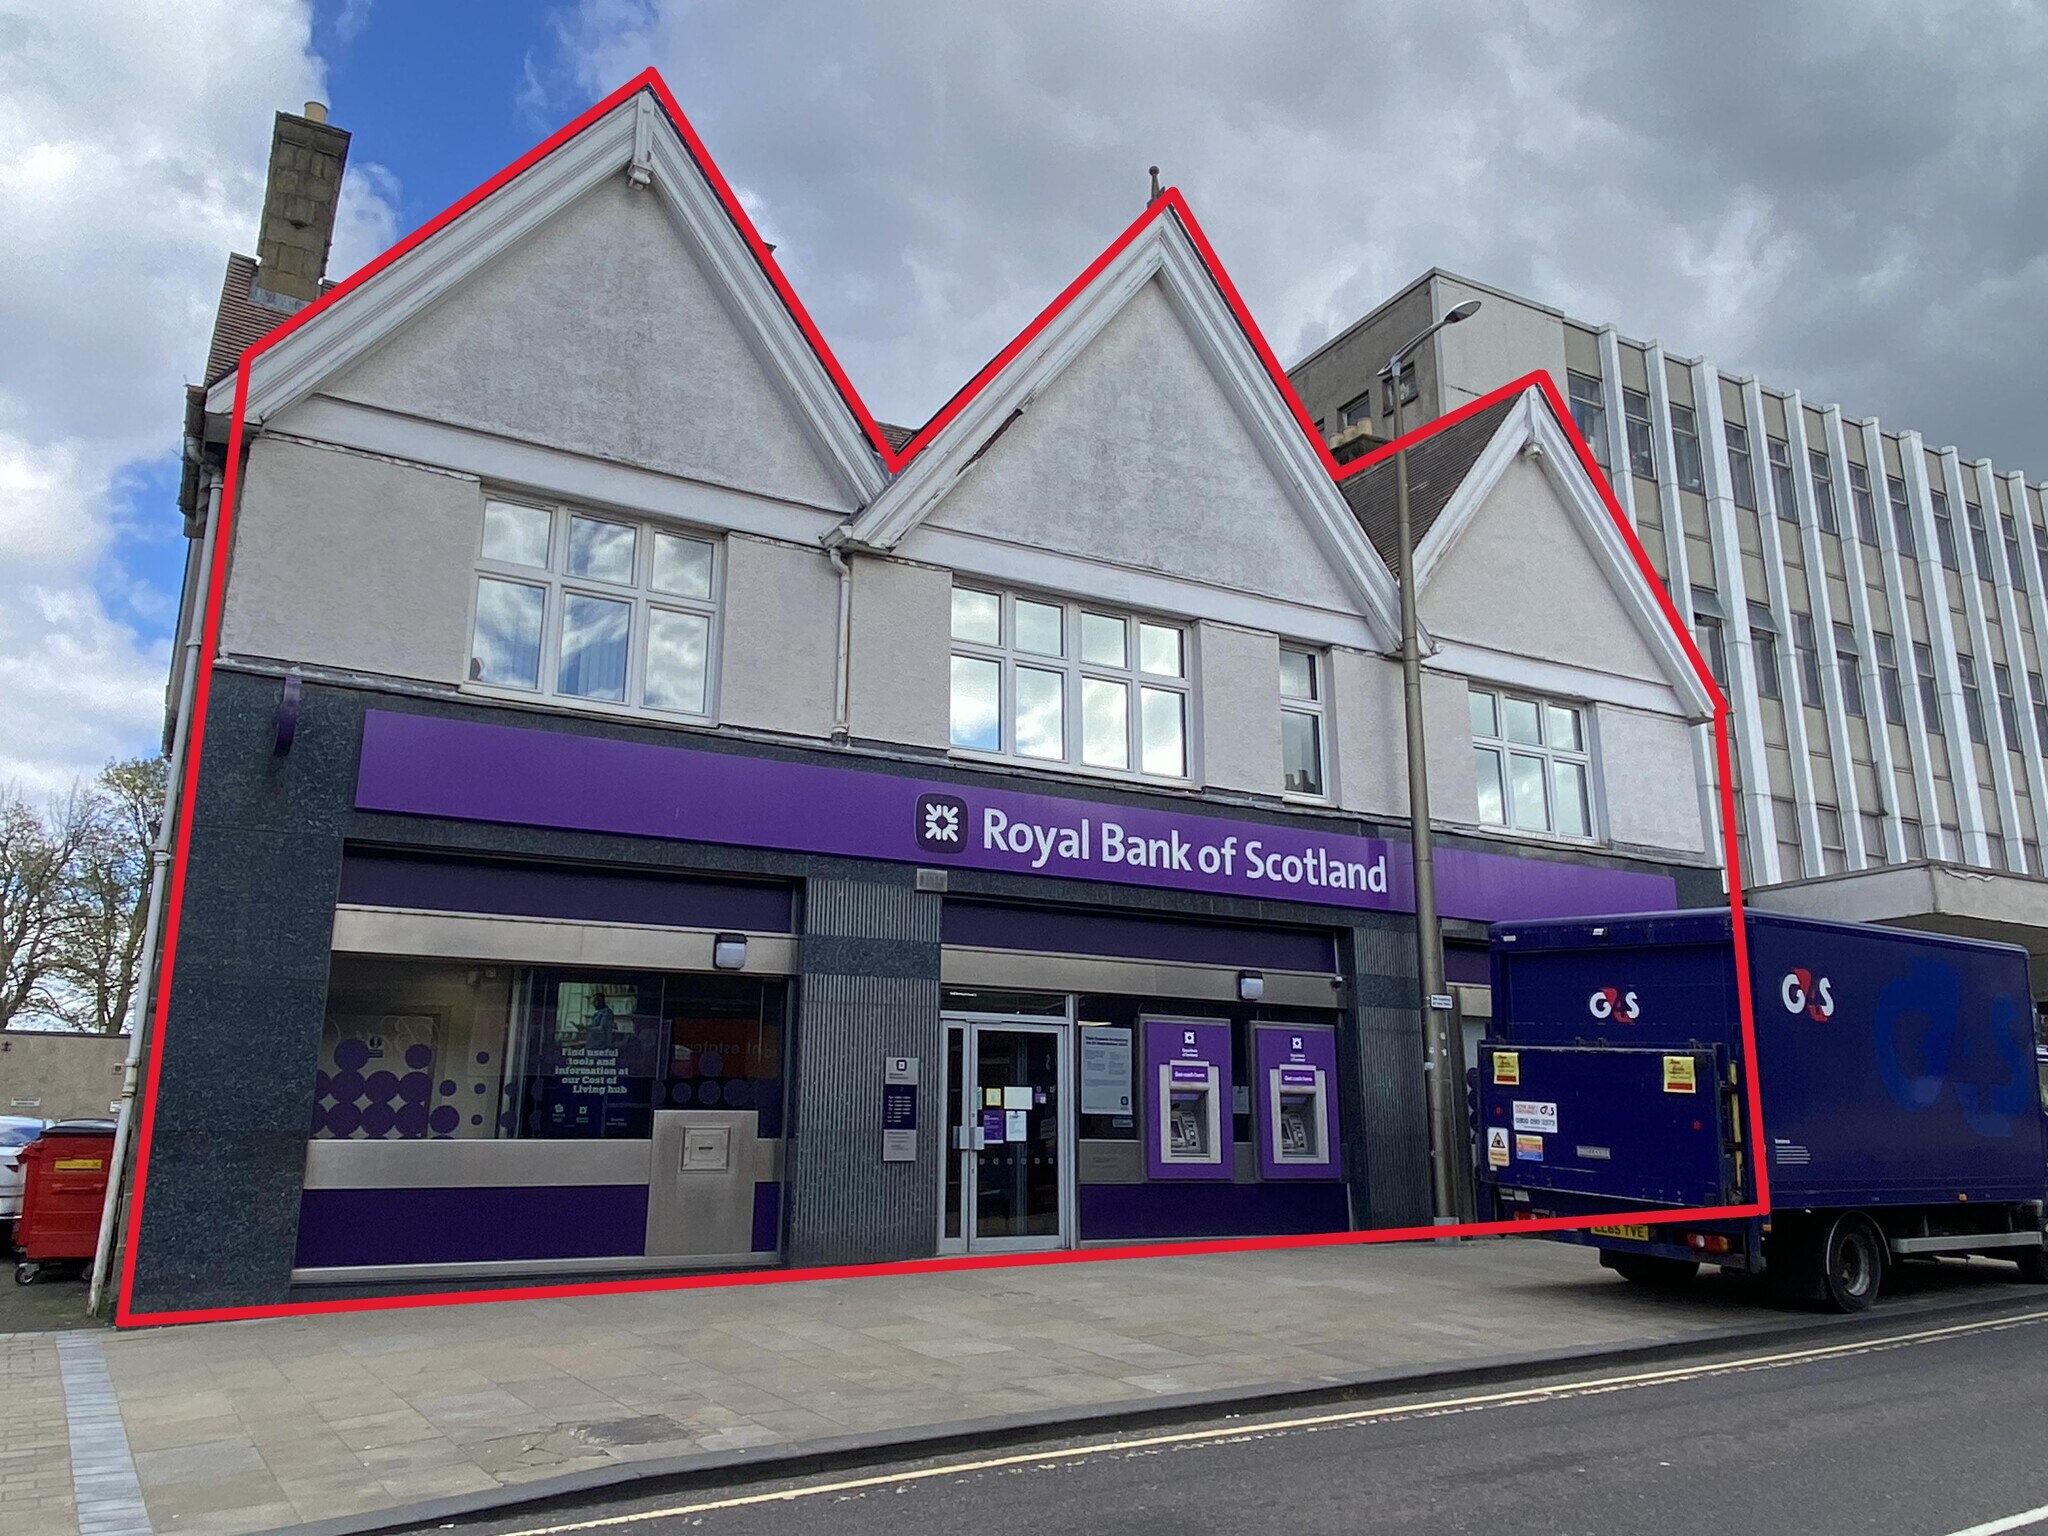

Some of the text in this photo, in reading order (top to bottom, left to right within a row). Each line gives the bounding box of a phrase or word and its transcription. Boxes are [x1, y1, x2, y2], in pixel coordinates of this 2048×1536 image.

[982, 807, 1388, 893] Royal Bank of Scotland
[1781, 967, 1835, 1023] G4S
[1588, 986, 1640, 1024] G4S
[561, 1047, 618, 1057] Find useful
[568, 1057, 616, 1066] tools and
[555, 1065, 629, 1075] information at
[582, 1075, 605, 1084] Cost
[606, 1076, 617, 1084] of
[572, 1084, 627, 1095] Living hub
[1623, 1224, 1645, 1239] TVE
